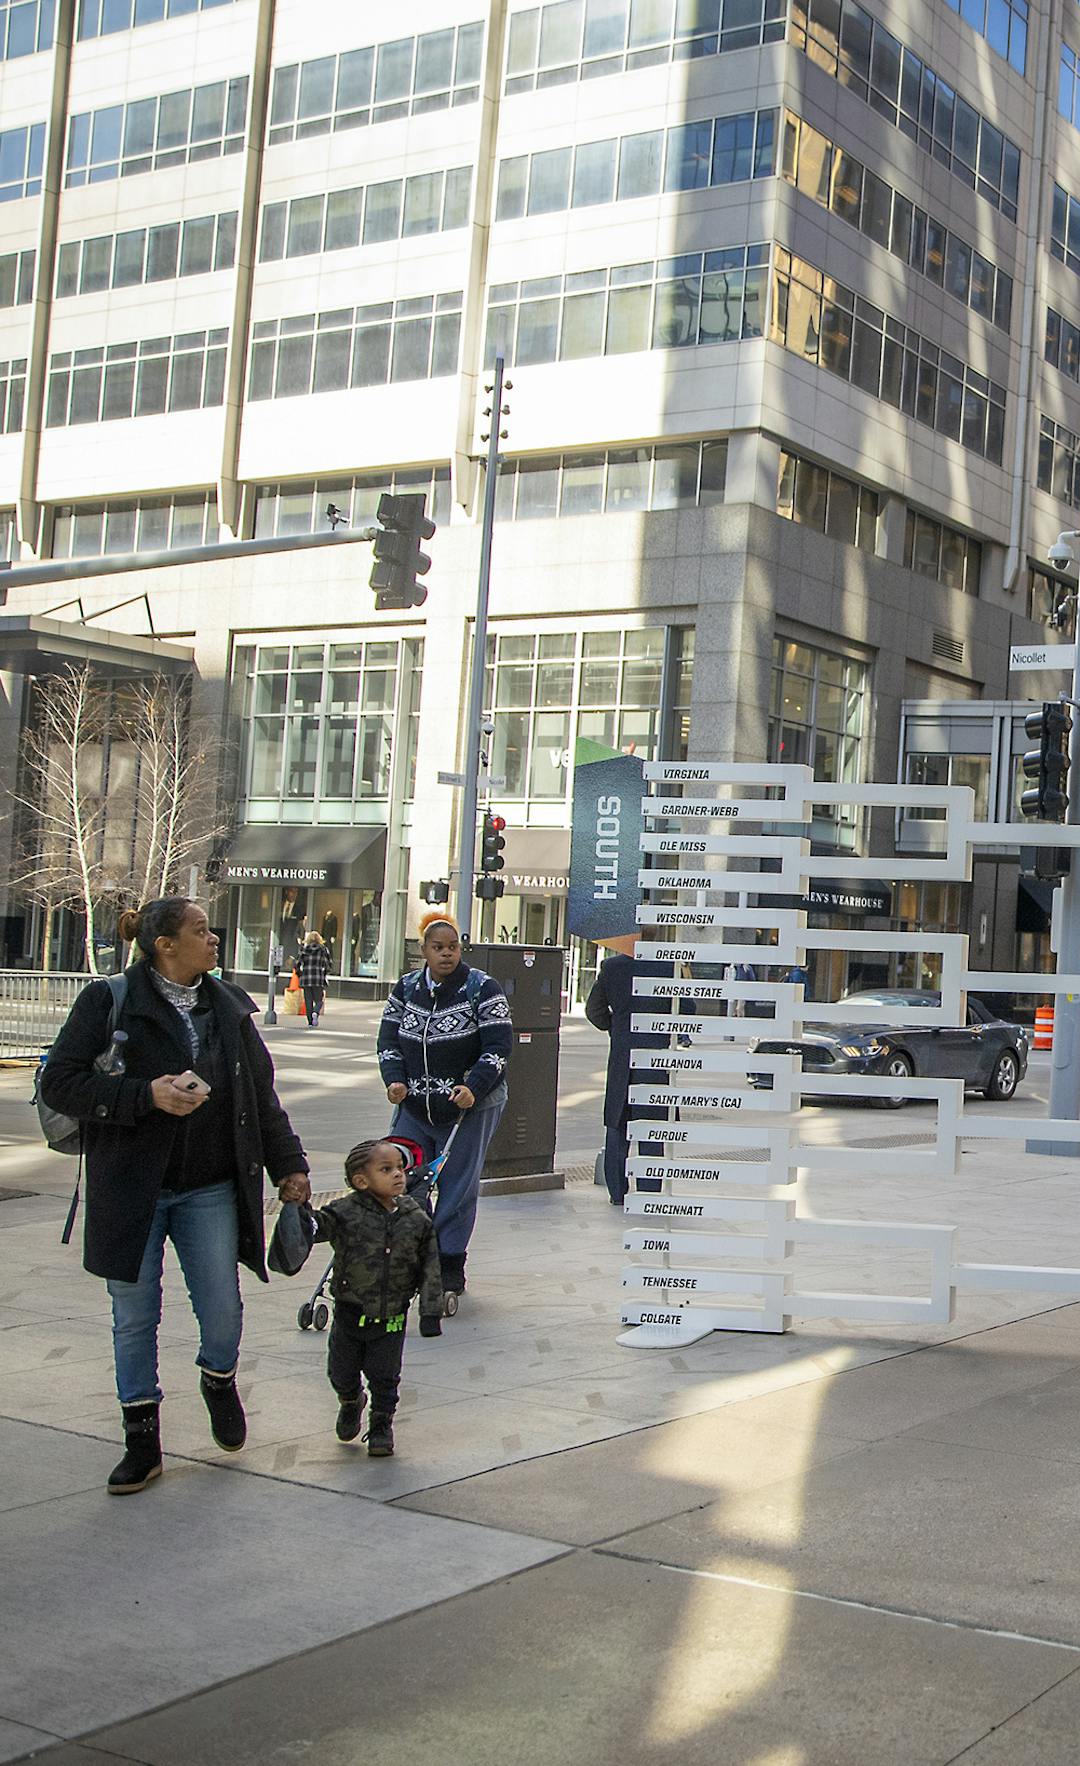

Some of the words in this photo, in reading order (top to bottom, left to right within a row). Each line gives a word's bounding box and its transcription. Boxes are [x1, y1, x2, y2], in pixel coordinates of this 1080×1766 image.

[1012, 652, 1046, 664] Nicollet
[664, 769, 709, 779] VIRGINIA
[661, 806, 739, 816] GARDNER-WEBB
[594, 796, 621, 900] SOUTH
[660, 841, 677, 851] OLE
[679, 841, 706, 852] MISS
[228, 867, 257, 877] MEN'S
[261, 867, 325, 880] WEARHOUSE
[658, 877, 711, 888] OKLAHOMA
[832, 894, 882, 908] WEARHOUSE
[656, 913, 714, 924] WISCONSIN
[655, 950, 695, 960] OREGON
[653, 986, 692, 997] KANSAS
[694, 987, 722, 998] STATE
[651, 1021, 666, 1032] UC
[668, 1022, 702, 1033] IRVINE
[650, 1058, 703, 1069] VILLANOVA
[649, 1094, 679, 1106] SAINT
[681, 1096, 719, 1107] MARY'S
[721, 1096, 741, 1108] (CA)
[648, 1130, 688, 1142] PURDUE
[645, 1167, 665, 1178] OLD
[666, 1168, 719, 1180] DOMINION
[644, 1203, 704, 1216] CINCINNATI
[642, 1239, 670, 1251] IOWA
[642, 1276, 697, 1289] TENNESSEE
[640, 1313, 682, 1325] COLGATE
